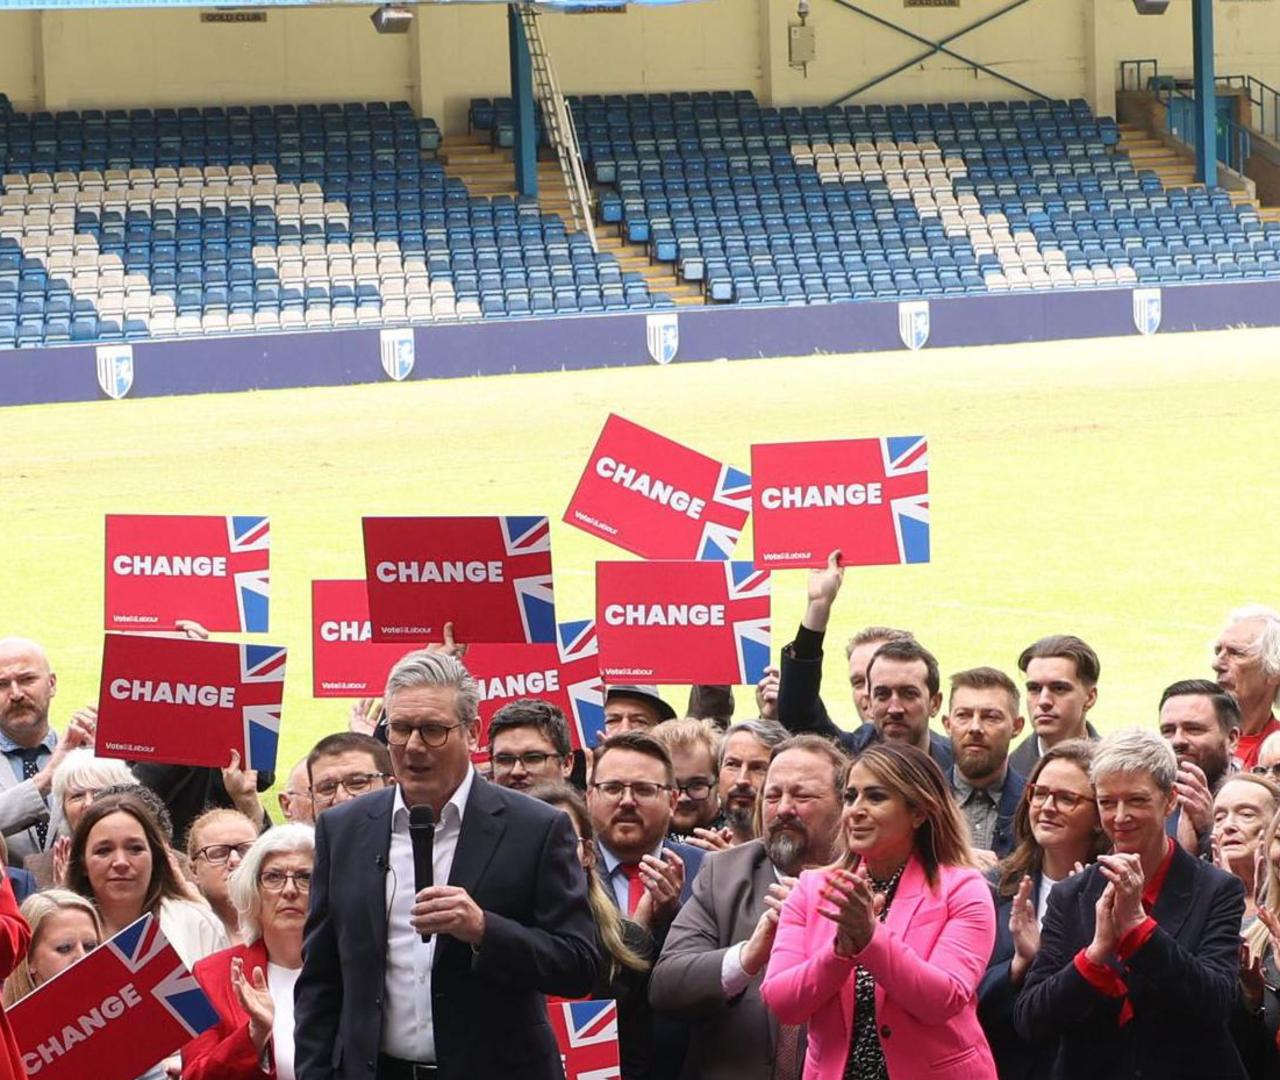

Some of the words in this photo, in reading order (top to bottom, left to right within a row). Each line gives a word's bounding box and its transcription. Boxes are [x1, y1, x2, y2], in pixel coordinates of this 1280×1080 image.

[596, 456, 706, 520] CHANGE
[761, 482, 882, 509] CHANGE
[113, 555, 227, 577] CHANGE
[376, 561, 504, 583] CHANGE
[604, 604, 725, 626] CHANGE
[320, 620, 372, 642] CHA
[381, 626, 400, 634] Vote
[110, 678, 236, 709] CHANGE
[20, 982, 142, 1076] CHANGE
